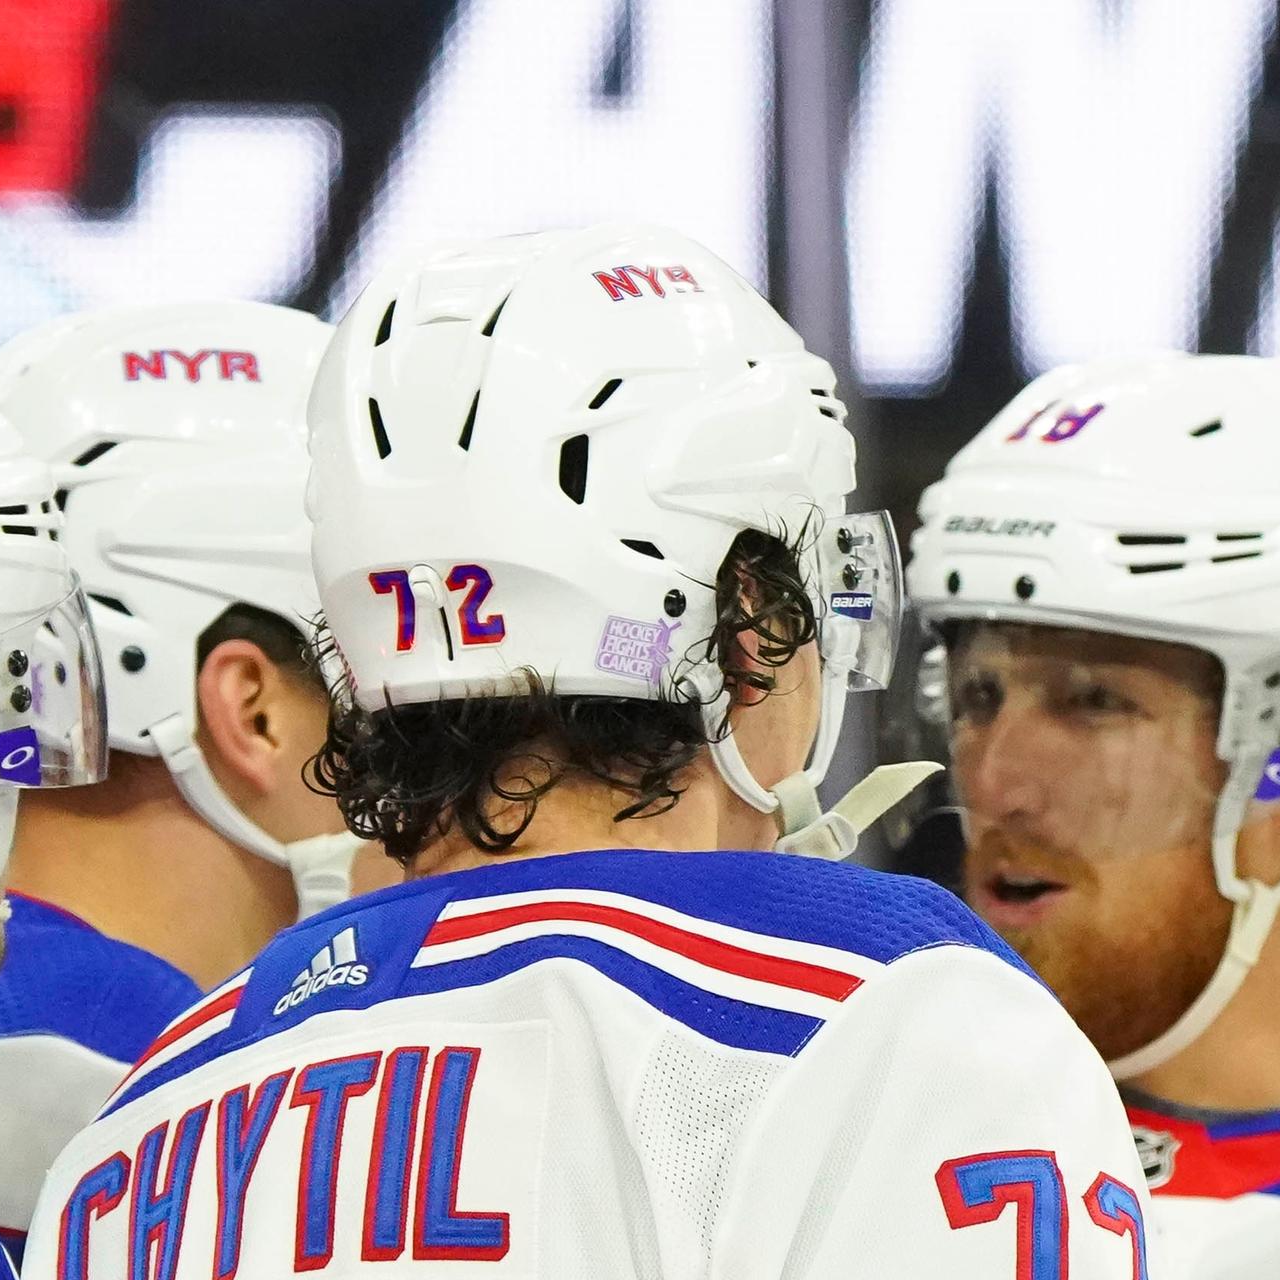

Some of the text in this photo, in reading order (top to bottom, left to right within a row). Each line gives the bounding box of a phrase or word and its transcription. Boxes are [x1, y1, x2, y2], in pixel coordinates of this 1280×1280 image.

[122, 350, 261, 383] NYR
[369, 564, 505, 652] 72
[609, 620, 662, 641] HOCKEY
[599, 652, 654, 677] CANCER
[273, 963, 369, 1016] adidas
